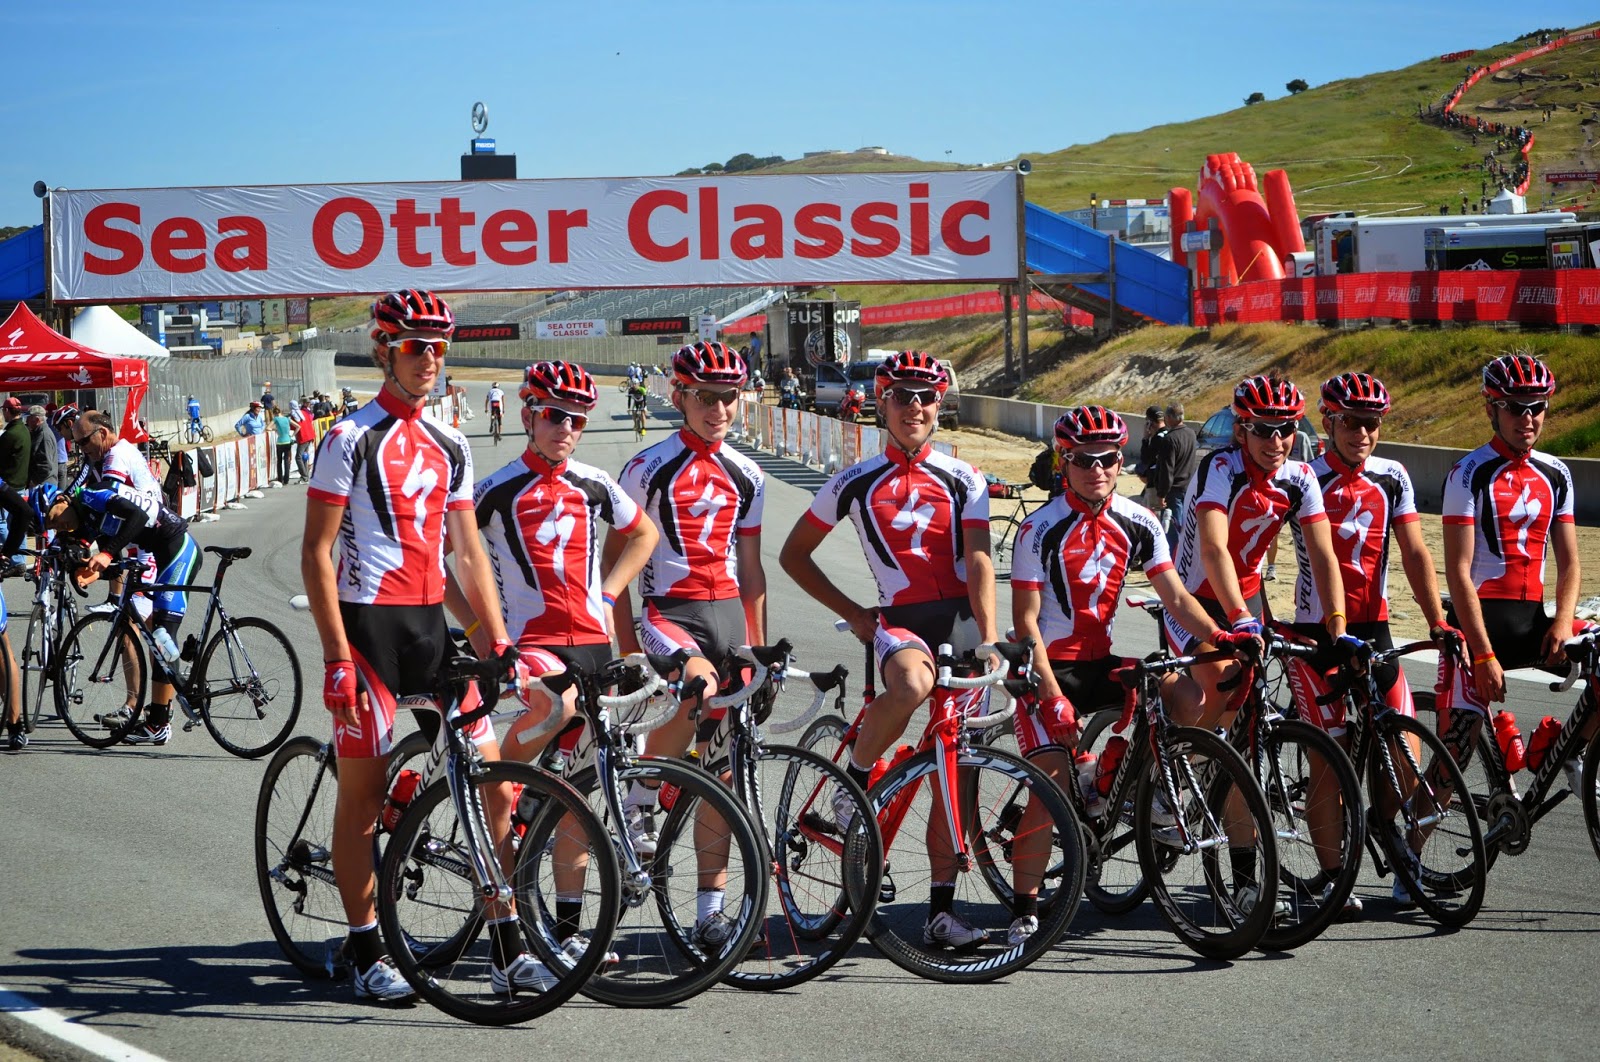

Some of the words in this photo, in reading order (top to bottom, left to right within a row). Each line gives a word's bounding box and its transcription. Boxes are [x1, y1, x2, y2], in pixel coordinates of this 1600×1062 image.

[84, 202, 268, 275] Sea
[313, 197, 588, 269] Otter
[628, 184, 990, 262] Classic
[789, 311, 797, 324] THE
[798, 310, 822, 324] US
[834, 309, 860, 324] CUP
[458, 327, 512, 339] SRAM
[628, 320, 682, 332] SRAM
[4, 375, 47, 383] ZIPP
[832, 467, 862, 496] SPECIALIZED
[424, 853, 467, 876] S-WORKS
